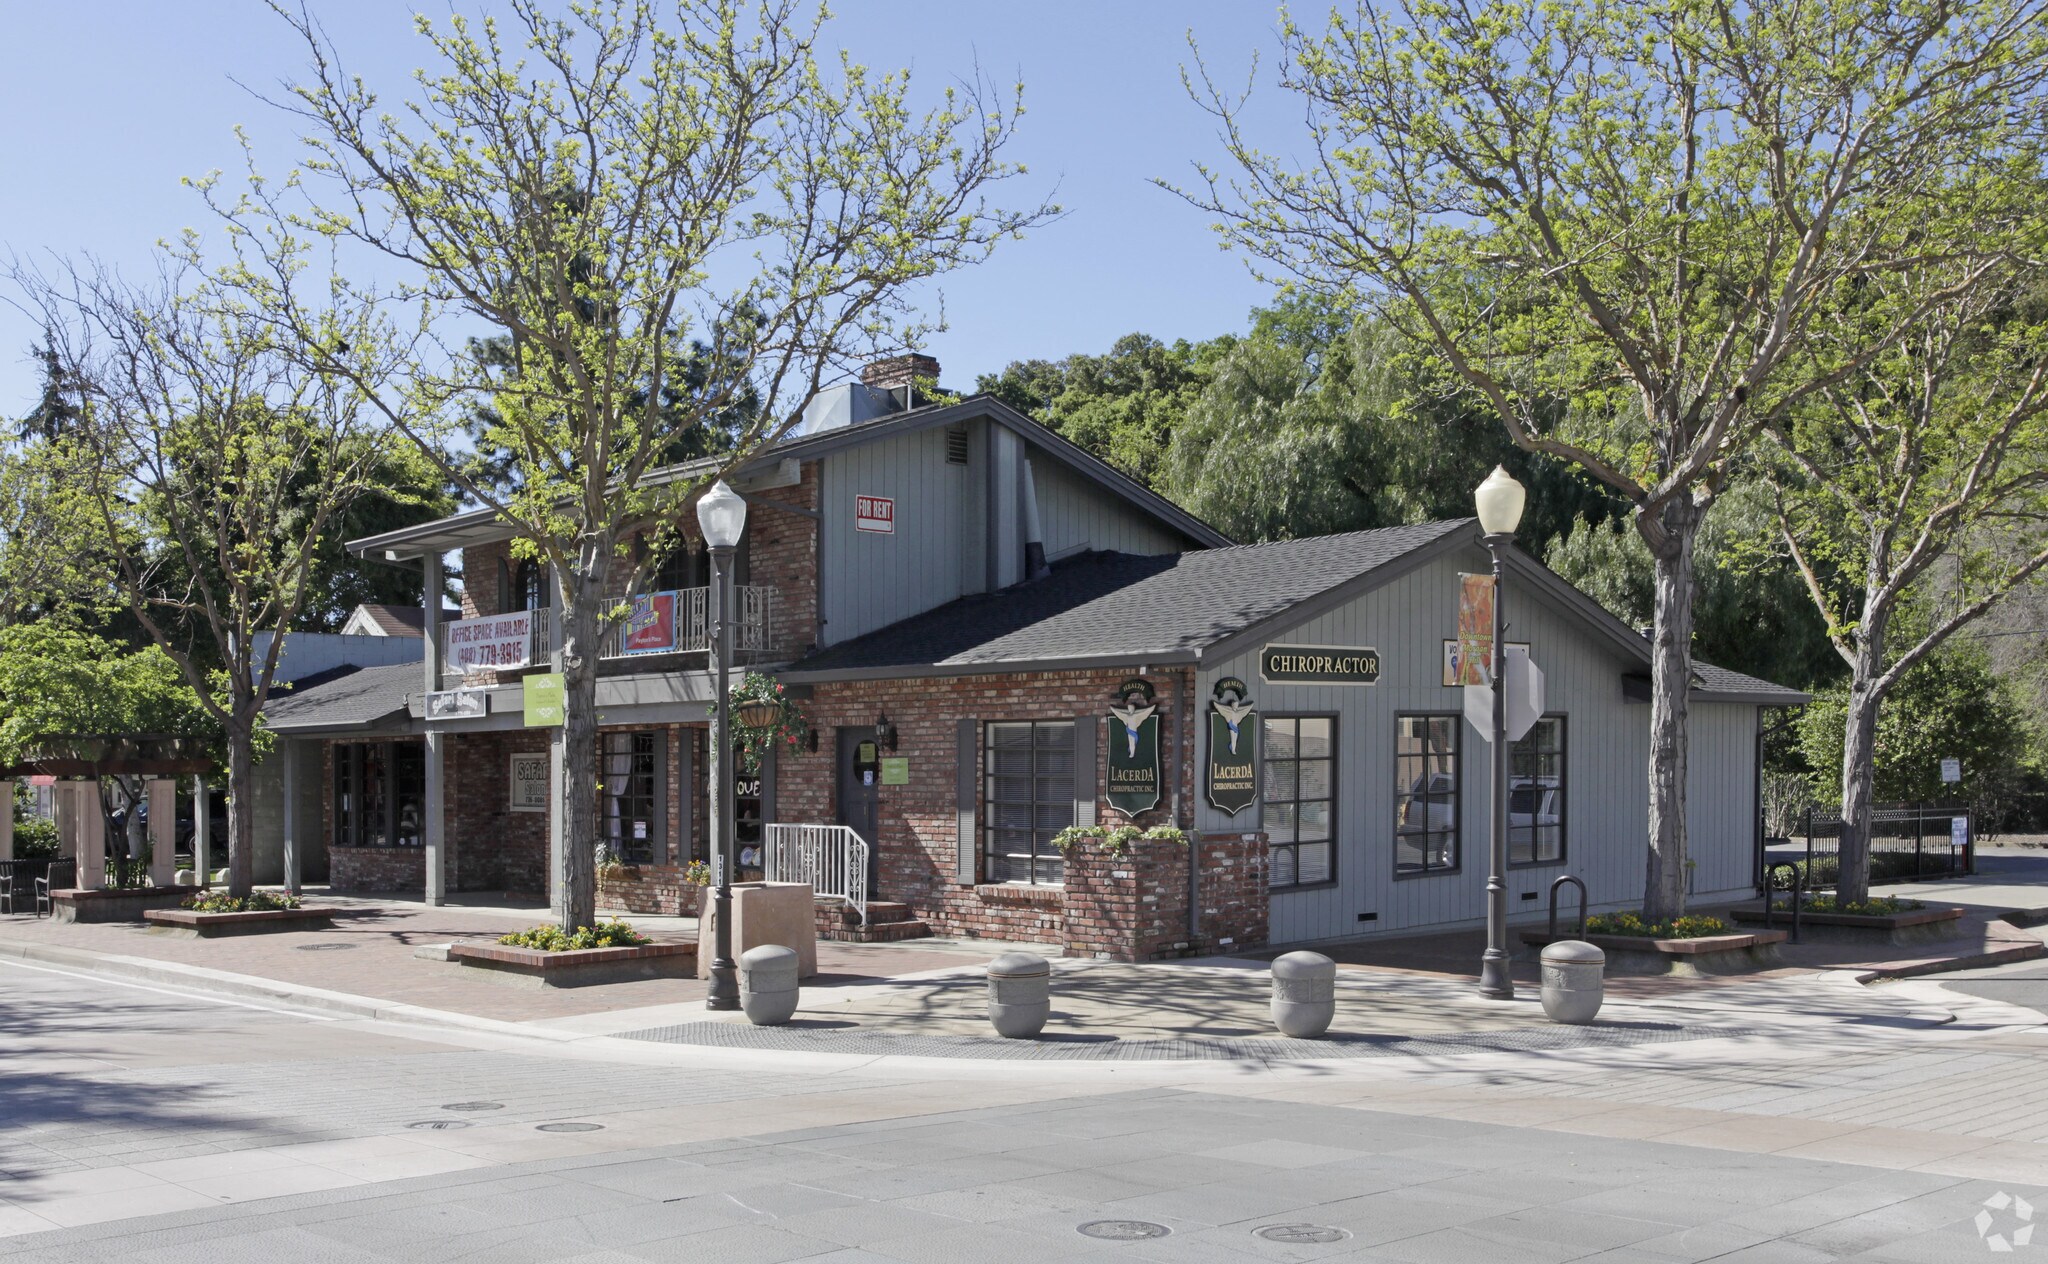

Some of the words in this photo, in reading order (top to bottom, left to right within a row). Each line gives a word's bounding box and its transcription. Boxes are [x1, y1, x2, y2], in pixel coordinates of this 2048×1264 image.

[858, 499, 872, 517] FOR
[873, 500, 892, 519] RENT
[451, 625, 472, 643] OFFICE
[473, 623, 493, 641] SPACE
[495, 618, 529, 639] AVAILABLE
[1460, 631, 1493, 641] Downtown
[457, 646, 477, 666] (408)
[479, 640, 522, 667] 779-3915
[1270, 655, 1377, 673] CHIROPRACTOR
[1123, 682, 1145, 692] HEALTH
[1223, 680, 1243, 690] HEALTH
[1111, 766, 1154, 782] LACERDA
[1213, 763, 1253, 779] LACERDA
[1110, 785, 1144, 793] CHIROPRACTIC
[1213, 782, 1244, 790] CHIROPRACTIC
